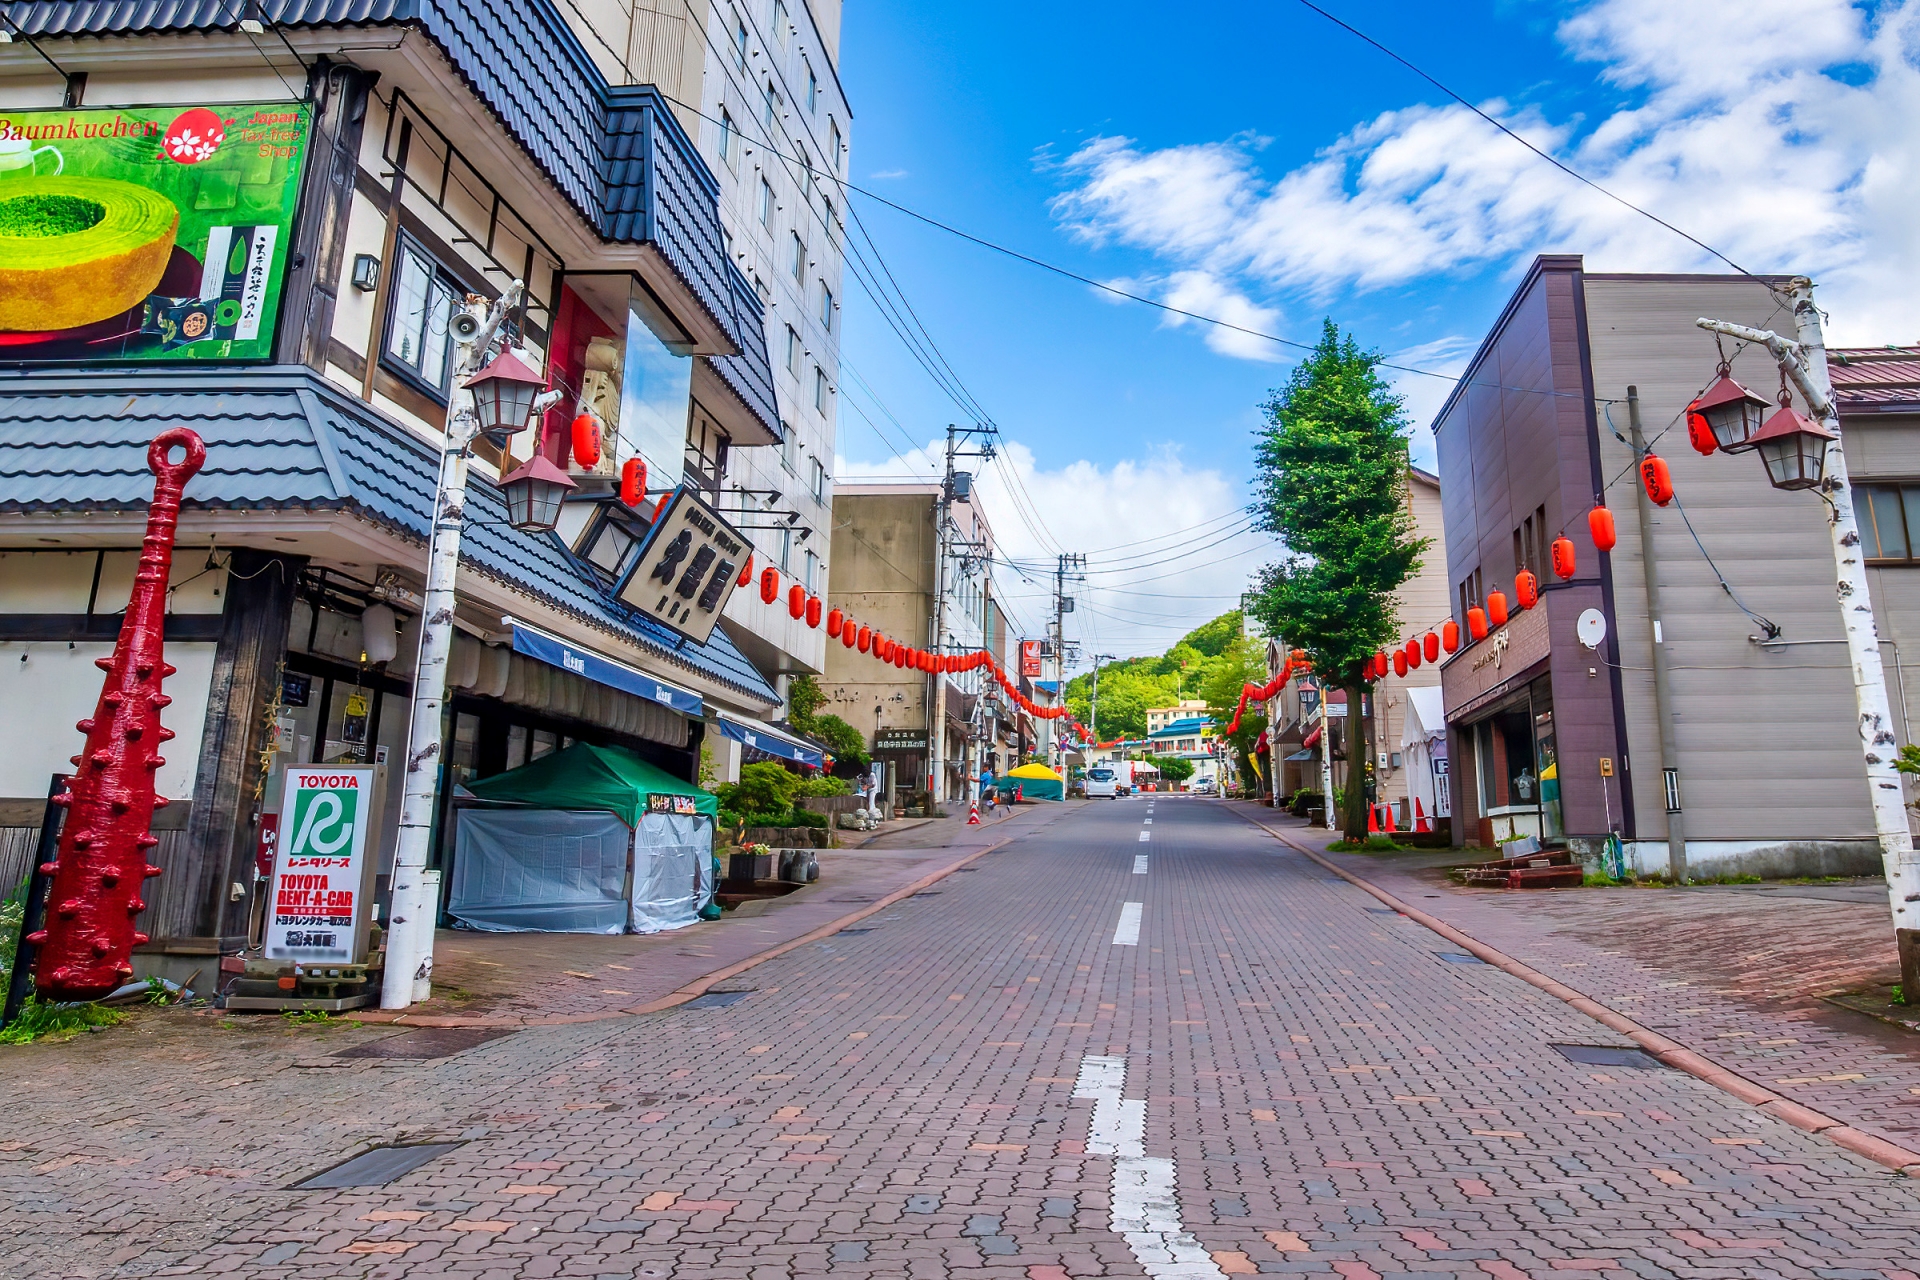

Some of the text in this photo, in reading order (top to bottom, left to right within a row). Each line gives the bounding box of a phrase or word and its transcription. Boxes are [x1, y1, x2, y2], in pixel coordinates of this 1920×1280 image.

[248, 111, 299, 126] Japan
[0, 115, 158, 141] Baumkuchen
[241, 128, 300, 142] Tax-free
[258, 143, 298, 159] Shop
[298, 775, 359, 789] TOYOTA
[287, 857, 351, 868] レンタリース
[280, 874, 329, 890] TOYOTA
[277, 890, 354, 907] RENT-A-CAR
